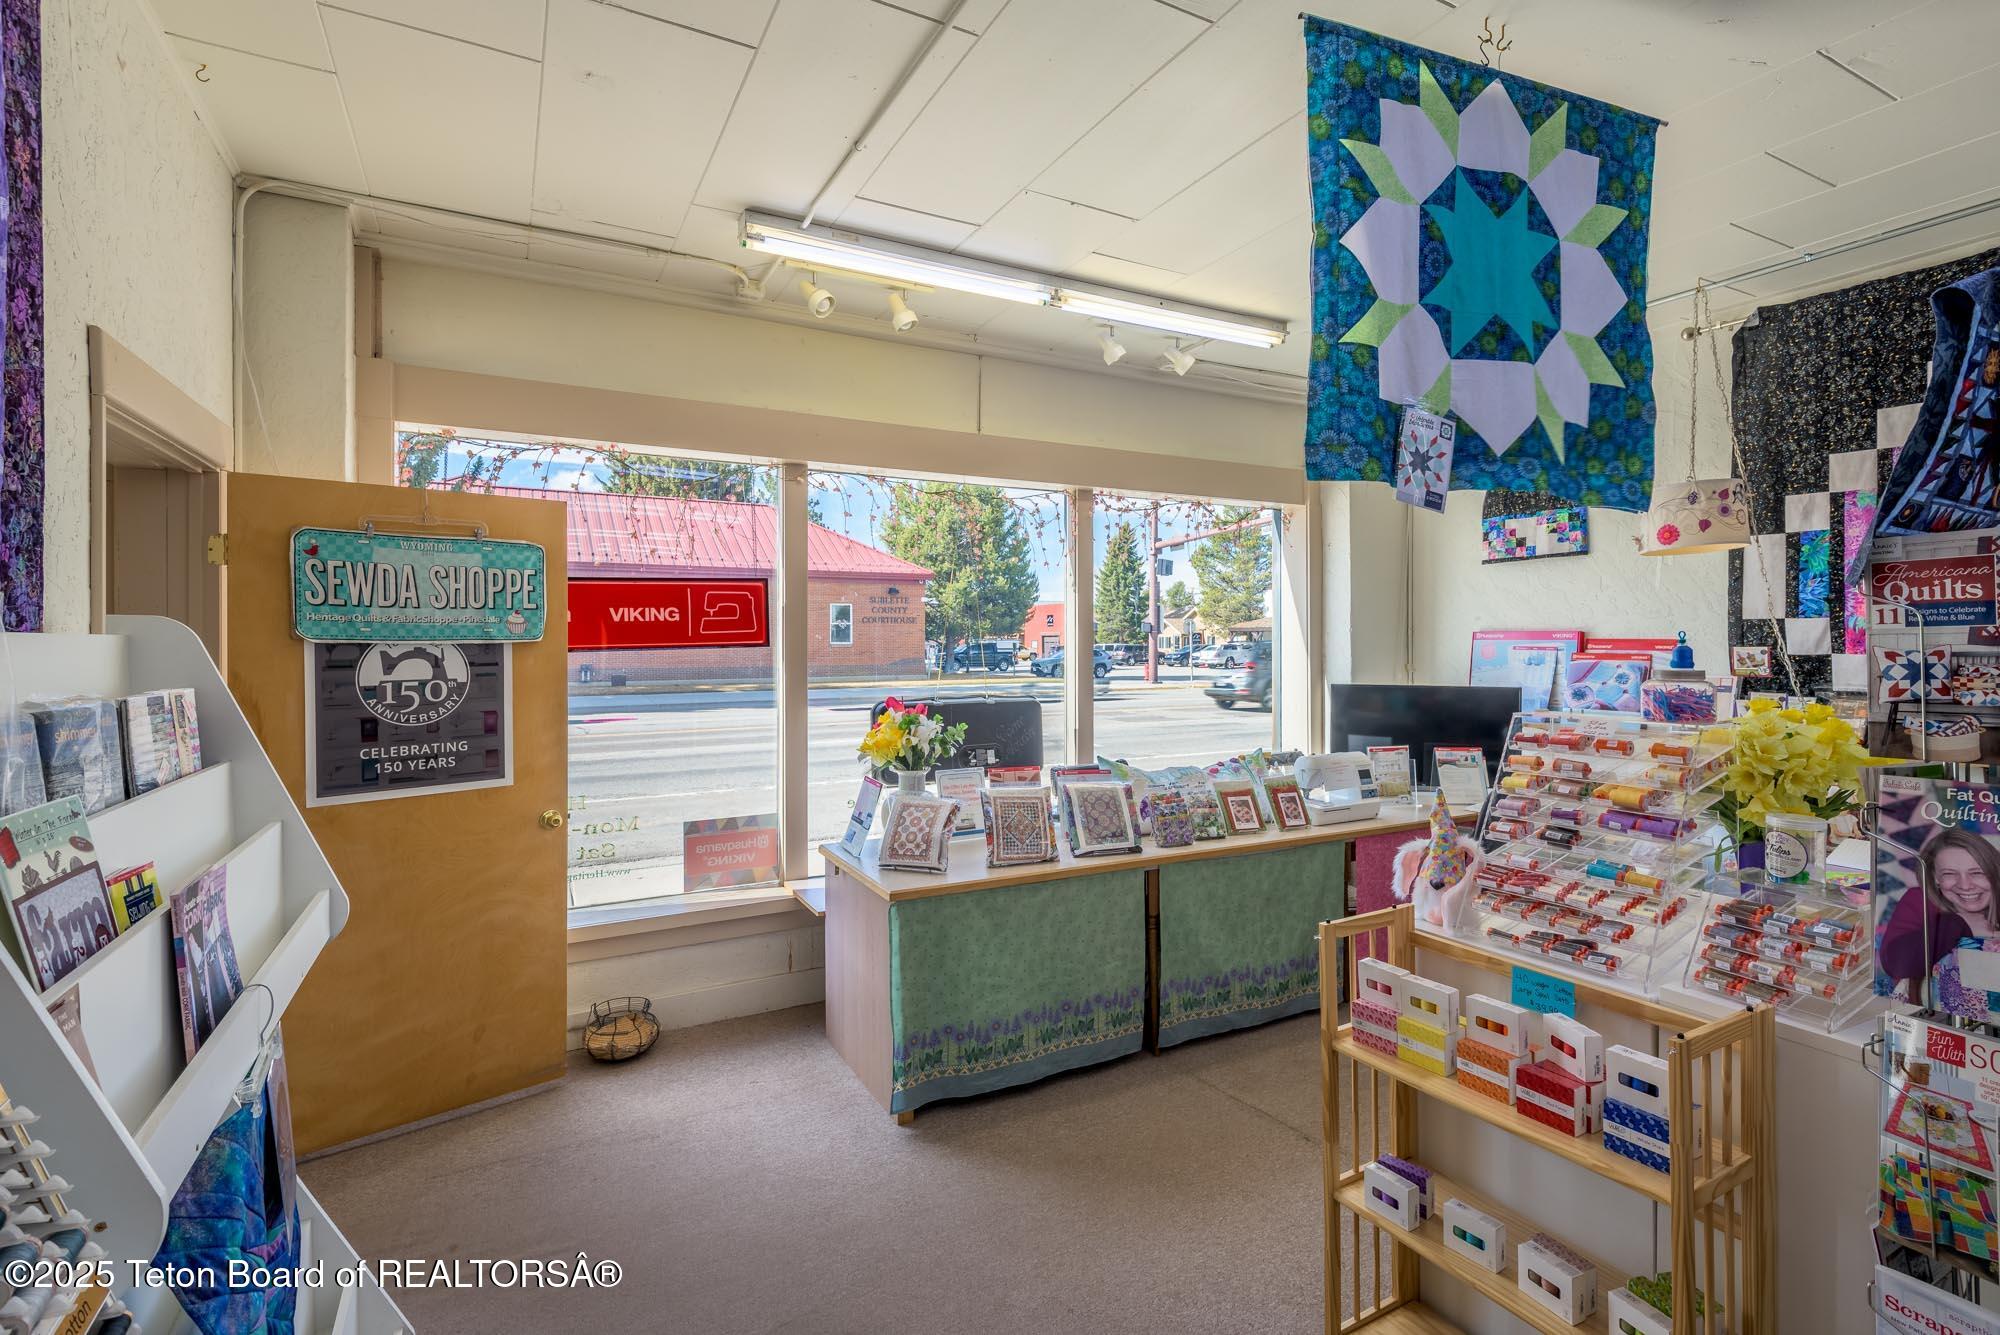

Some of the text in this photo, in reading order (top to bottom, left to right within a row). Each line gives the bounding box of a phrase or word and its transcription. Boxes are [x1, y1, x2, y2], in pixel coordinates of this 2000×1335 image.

[400, 541, 453, 552] WYOMING
[1872, 563, 1992, 586] Americana
[304, 559, 538, 610] SEWDA SHOPPE
[1883, 578, 1984, 605] Quilts
[307, 612, 351, 624] Heritage
[353, 614, 383, 623] Quilts
[423, 616, 458, 626] Shoppe
[609, 607, 680, 622] VIKING
[1875, 607, 1902, 625] 11
[1908, 606, 1937, 615] Dsigns
[1948, 606, 1987, 614] Celebrate
[1926, 614, 1949, 622] White
[862, 616, 918, 624] COURTHOUSE
[366, 692, 460, 724] ANNIVERSARY
[359, 740, 469, 760] CELEBRATING
[374, 756, 456, 774] 150 YEARS
[1946, 788, 1975, 802] Fat
[1921, 801, 2000, 832] Quiltin
[1927, 1030, 1954, 1046] Fun
[1932, 1044, 1965, 1061] With
[1885, 1294, 1964, 1335] Scrap
